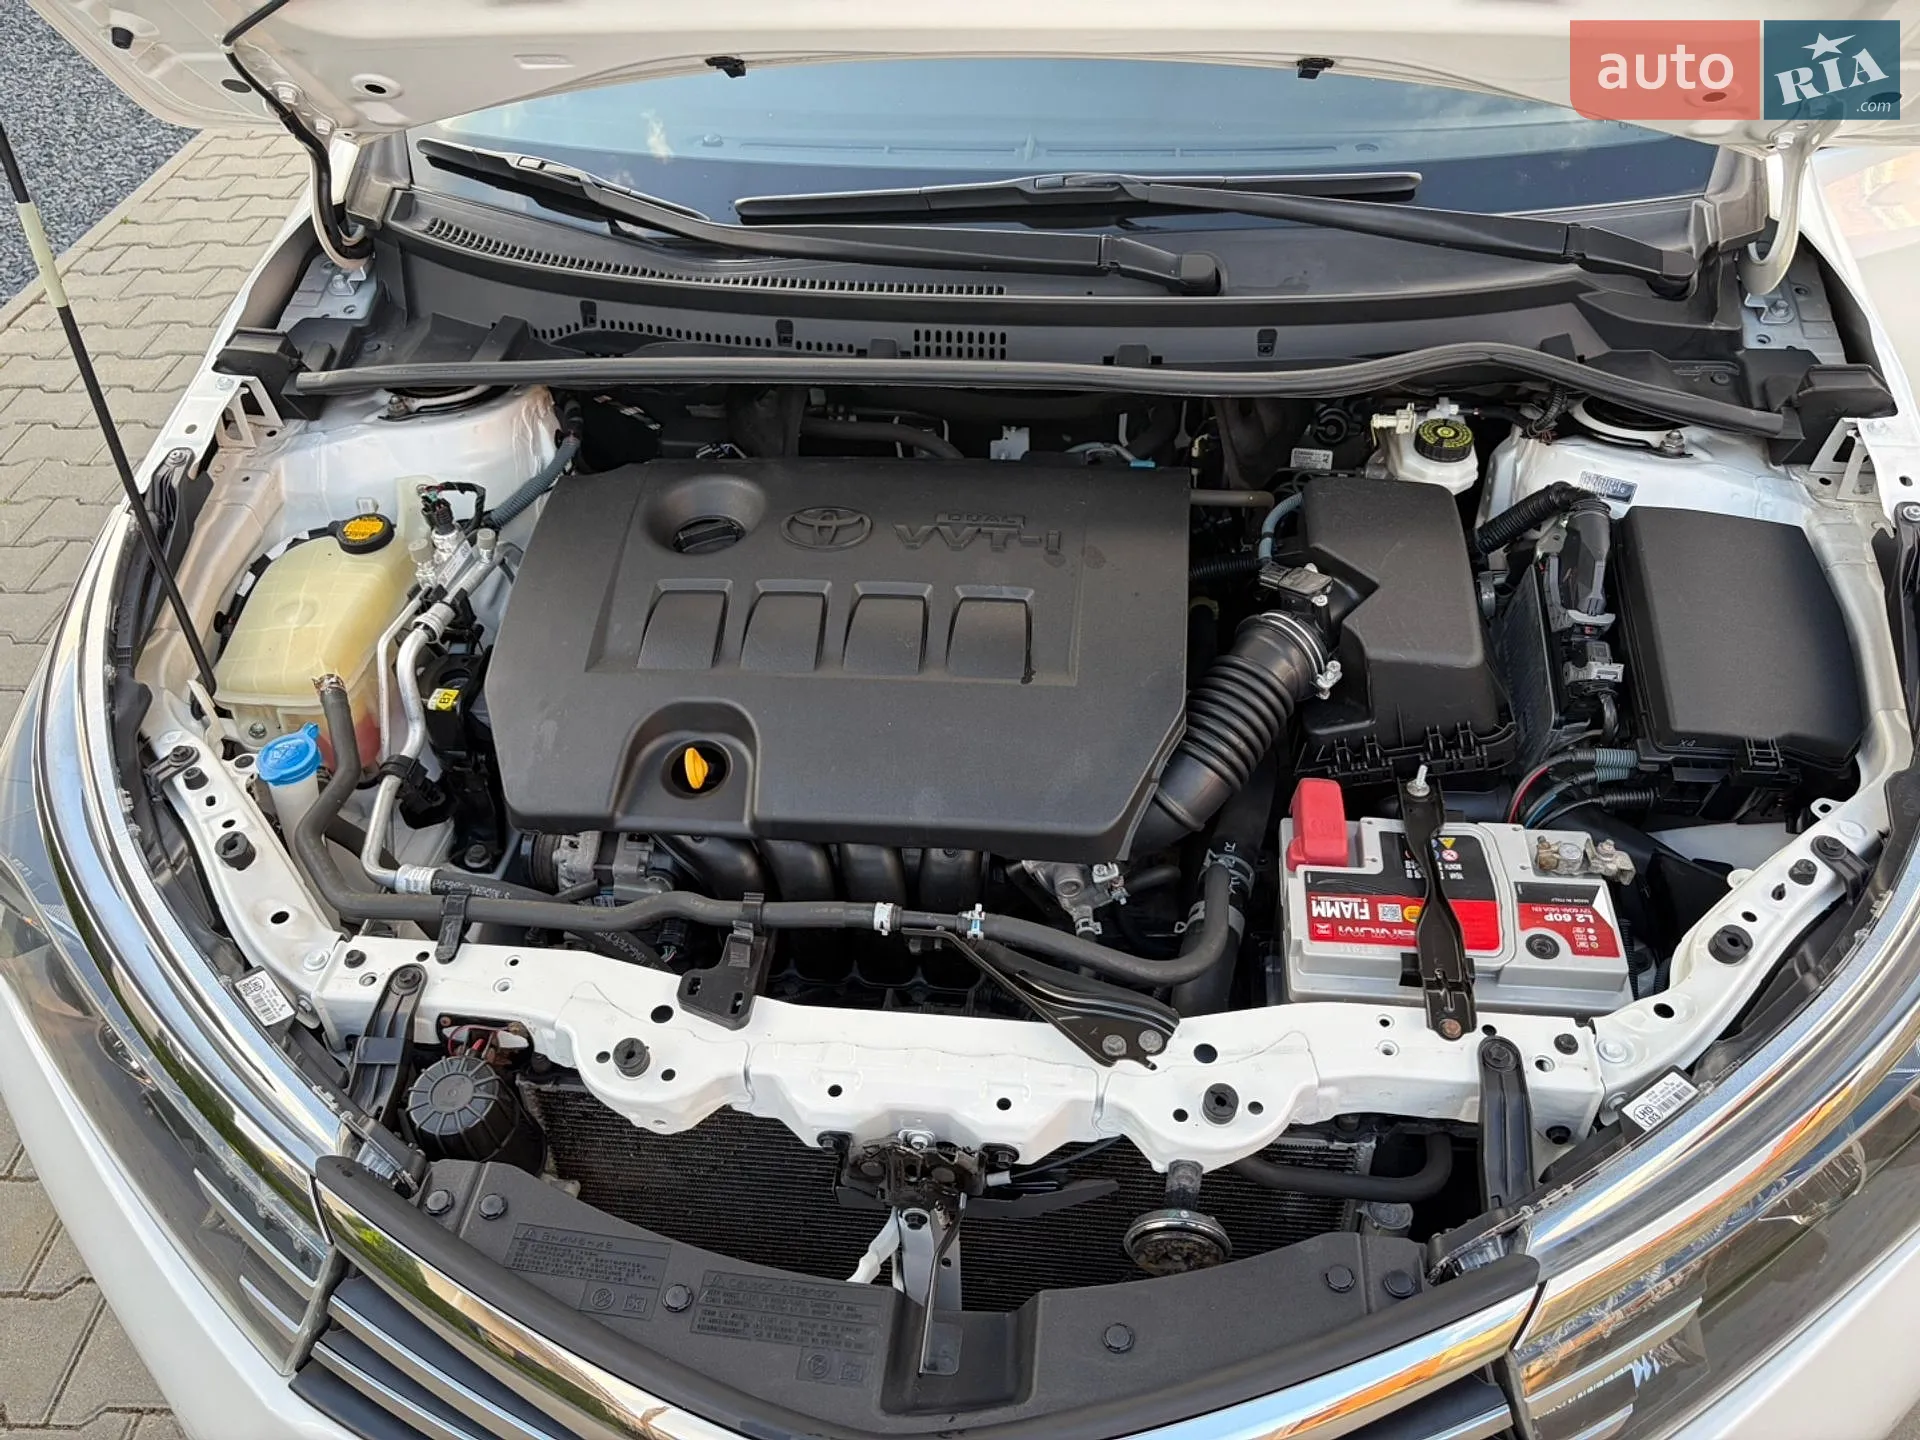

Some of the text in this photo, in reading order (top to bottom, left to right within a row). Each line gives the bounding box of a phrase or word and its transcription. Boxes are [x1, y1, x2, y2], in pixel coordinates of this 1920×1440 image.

[1311, 899, 1370, 920] FIAMM
[1544, 913, 1595, 923] L2 60P
[1636, 1106, 1654, 1121] LHD
